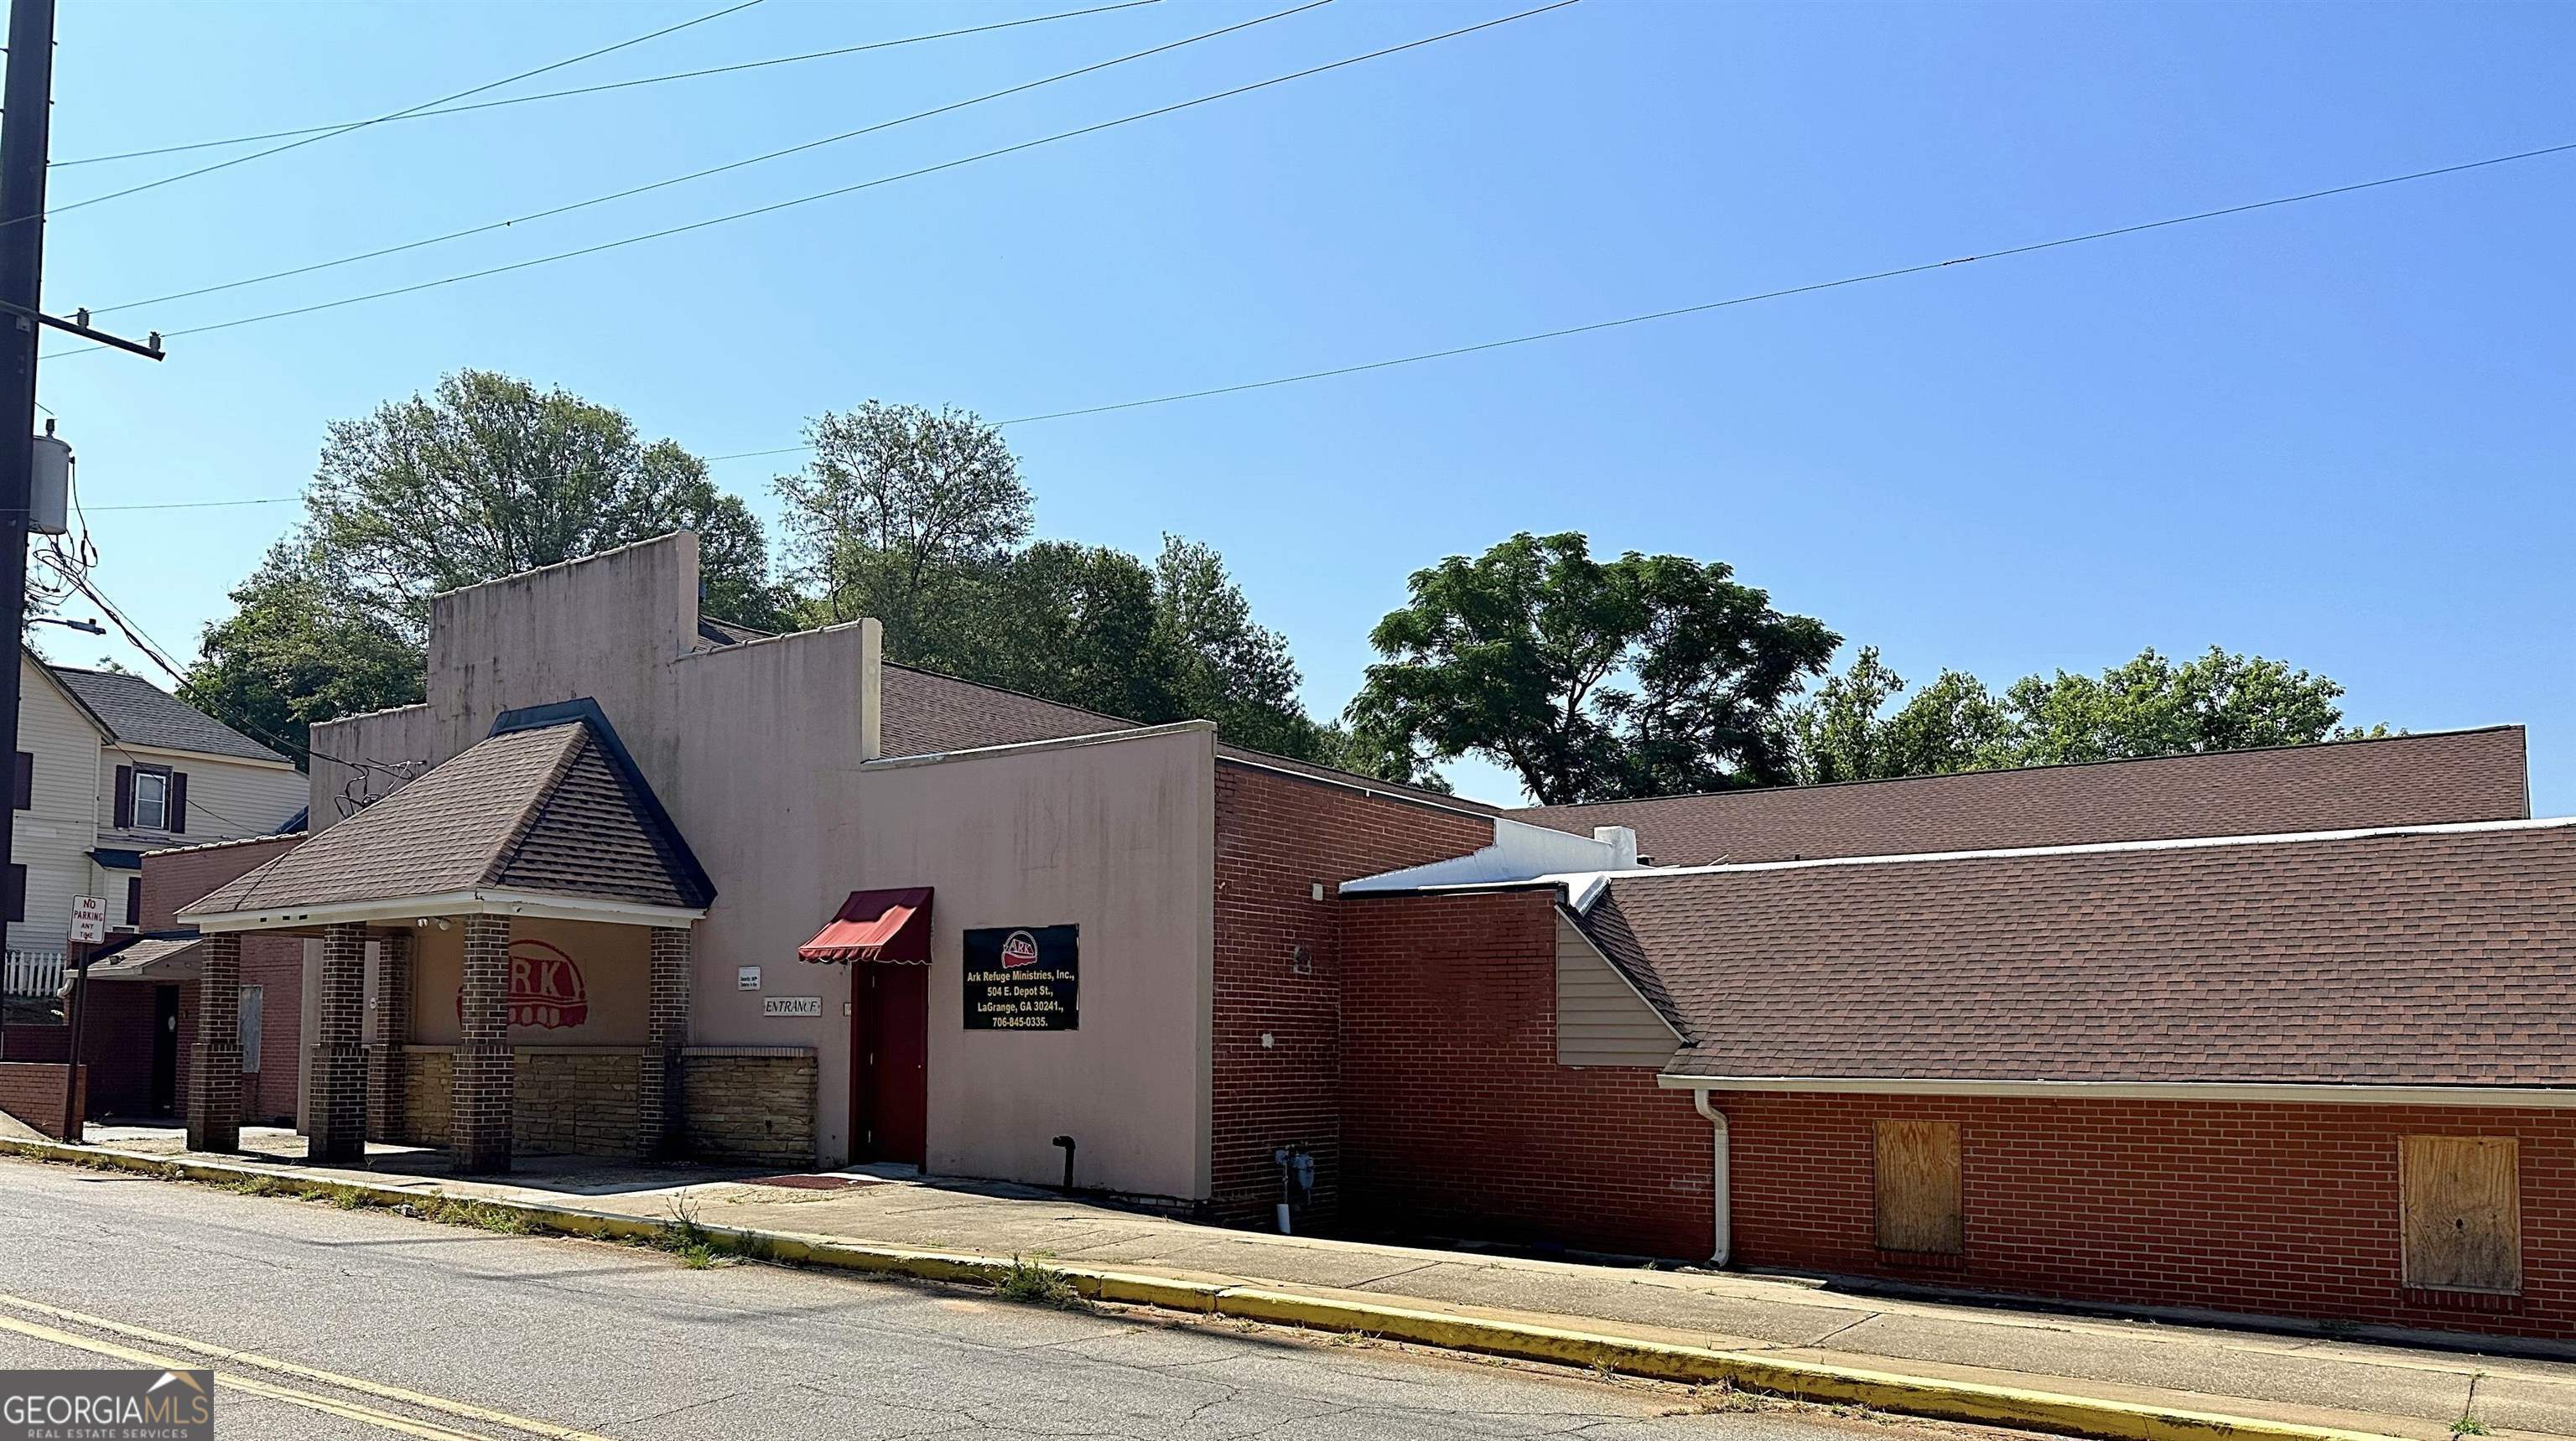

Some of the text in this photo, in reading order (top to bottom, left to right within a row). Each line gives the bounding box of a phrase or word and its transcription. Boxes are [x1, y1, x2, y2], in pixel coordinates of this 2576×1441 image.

[83, 899, 96, 909] NO
[74, 910, 103, 921] PARKING
[1009, 939, 1031, 954] ARK
[967, 969, 1074, 983] Ark Refuge Ministries, Inc.,
[987, 986, 1053, 998] 504 E. Depot St.,
[978, 1003, 1018, 1013] LaGrange,
[1020, 1002, 1032, 1011] GA
[992, 1017, 1048, 1027] 706-845-0335.
